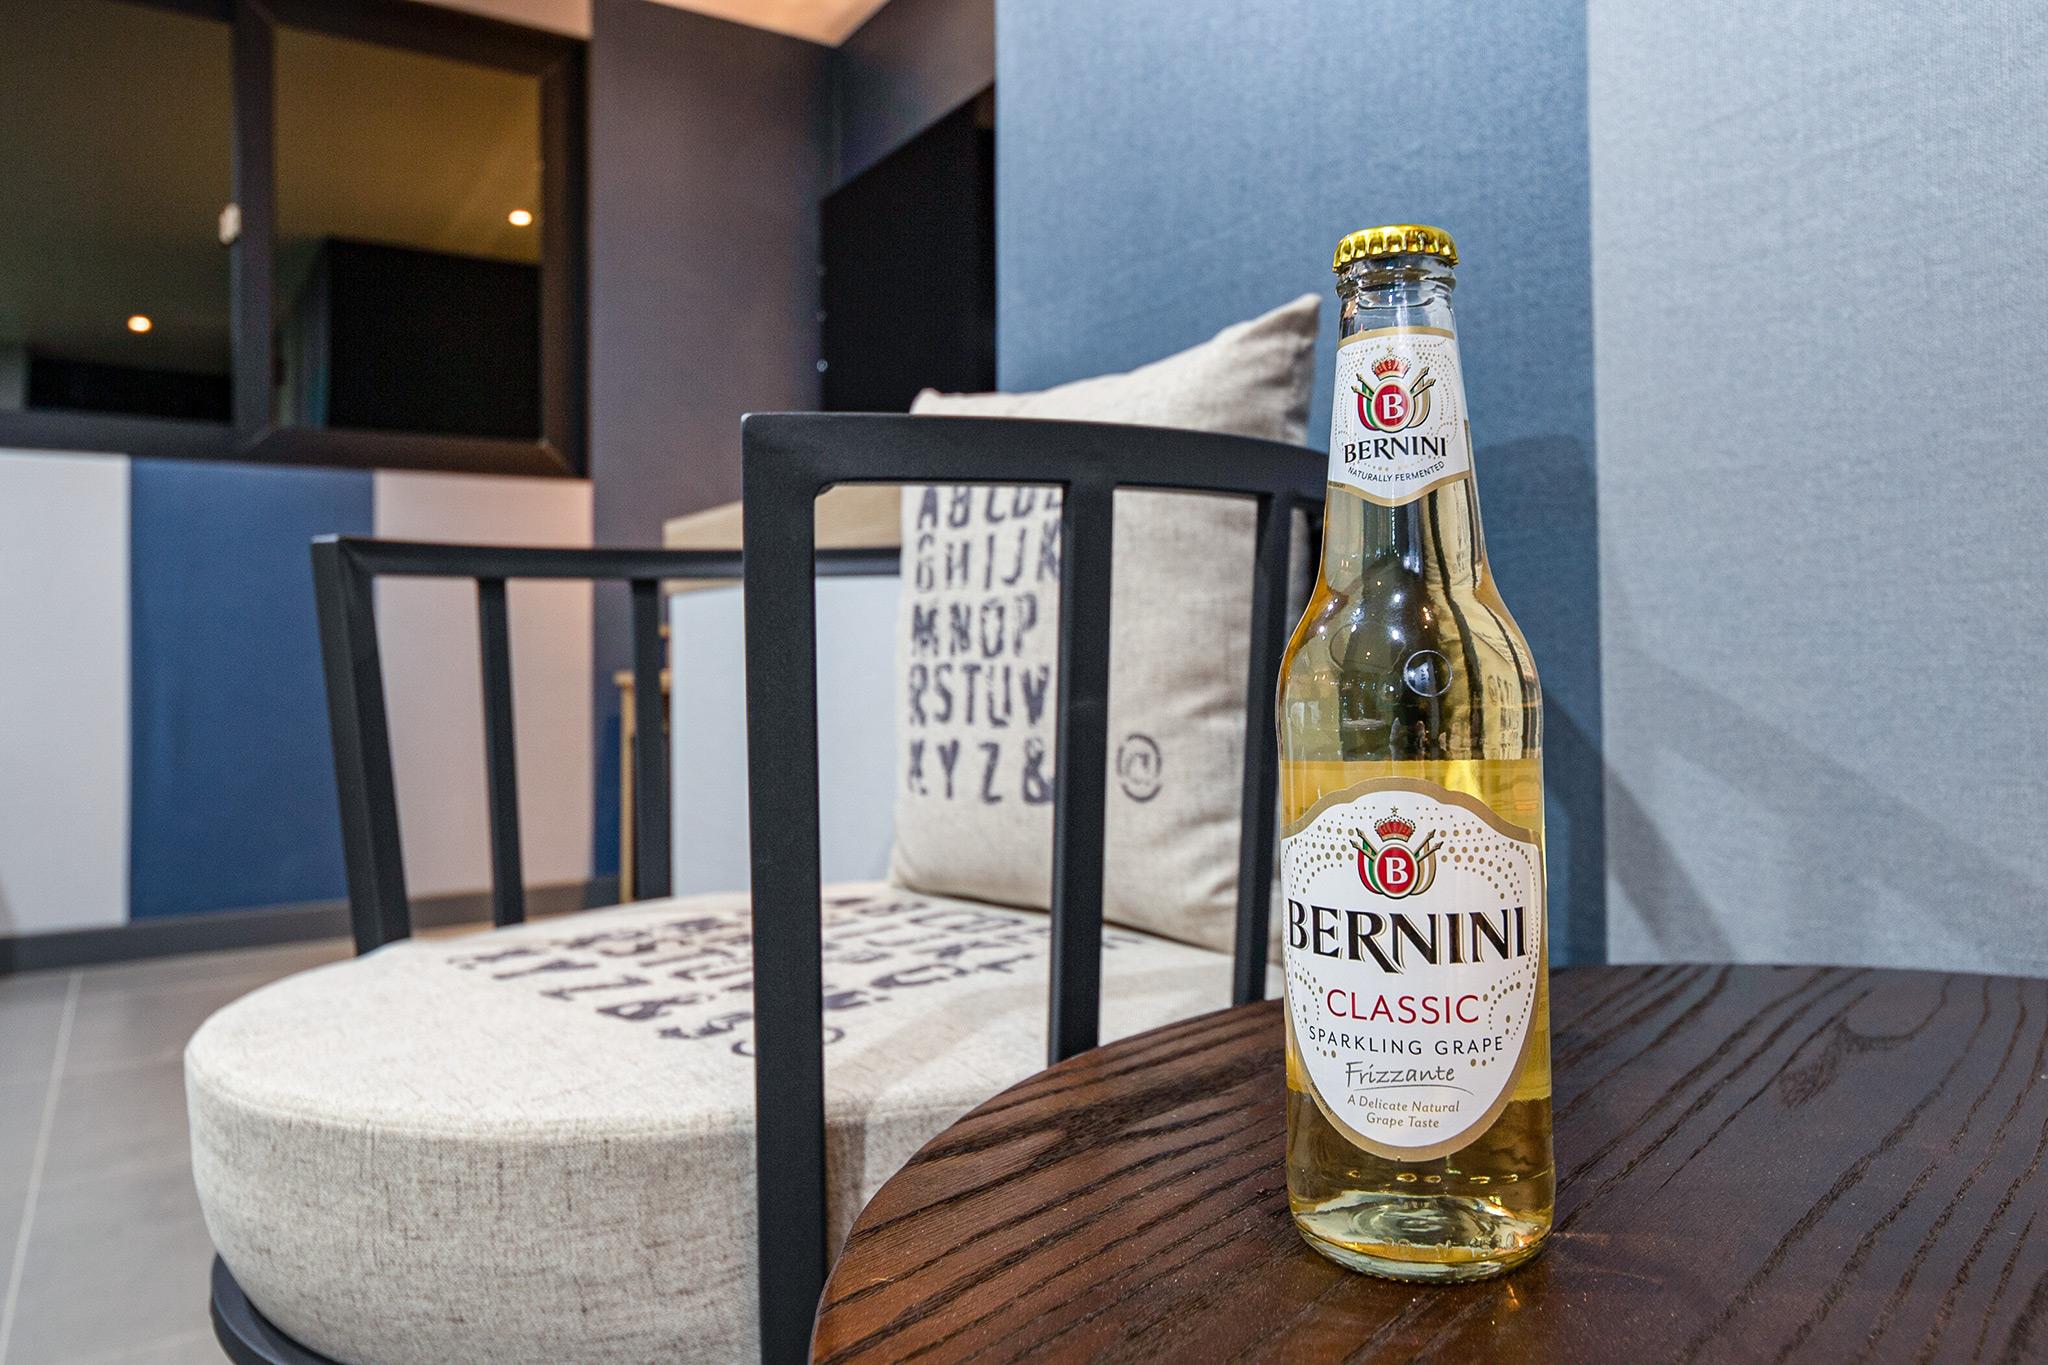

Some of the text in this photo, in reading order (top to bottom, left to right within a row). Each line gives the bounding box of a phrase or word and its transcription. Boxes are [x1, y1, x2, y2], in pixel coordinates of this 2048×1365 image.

[1382, 393, 1404, 420] B
[1344, 436, 1447, 464] BERNINI
[1348, 460, 1445, 483] NATURALLY FERMENTED
[1386, 856, 1409, 884] B
[1288, 898, 1529, 975] BERNINI
[1326, 988, 1480, 1025] CLASSIC
[1308, 1025, 1504, 1056] SPARKLING GRAPE
[1345, 1060, 1456, 1088] Frizzante
[1347, 1093, 1461, 1113] A Delicate Natural
[1366, 1111, 1440, 1129] Grape Taste
